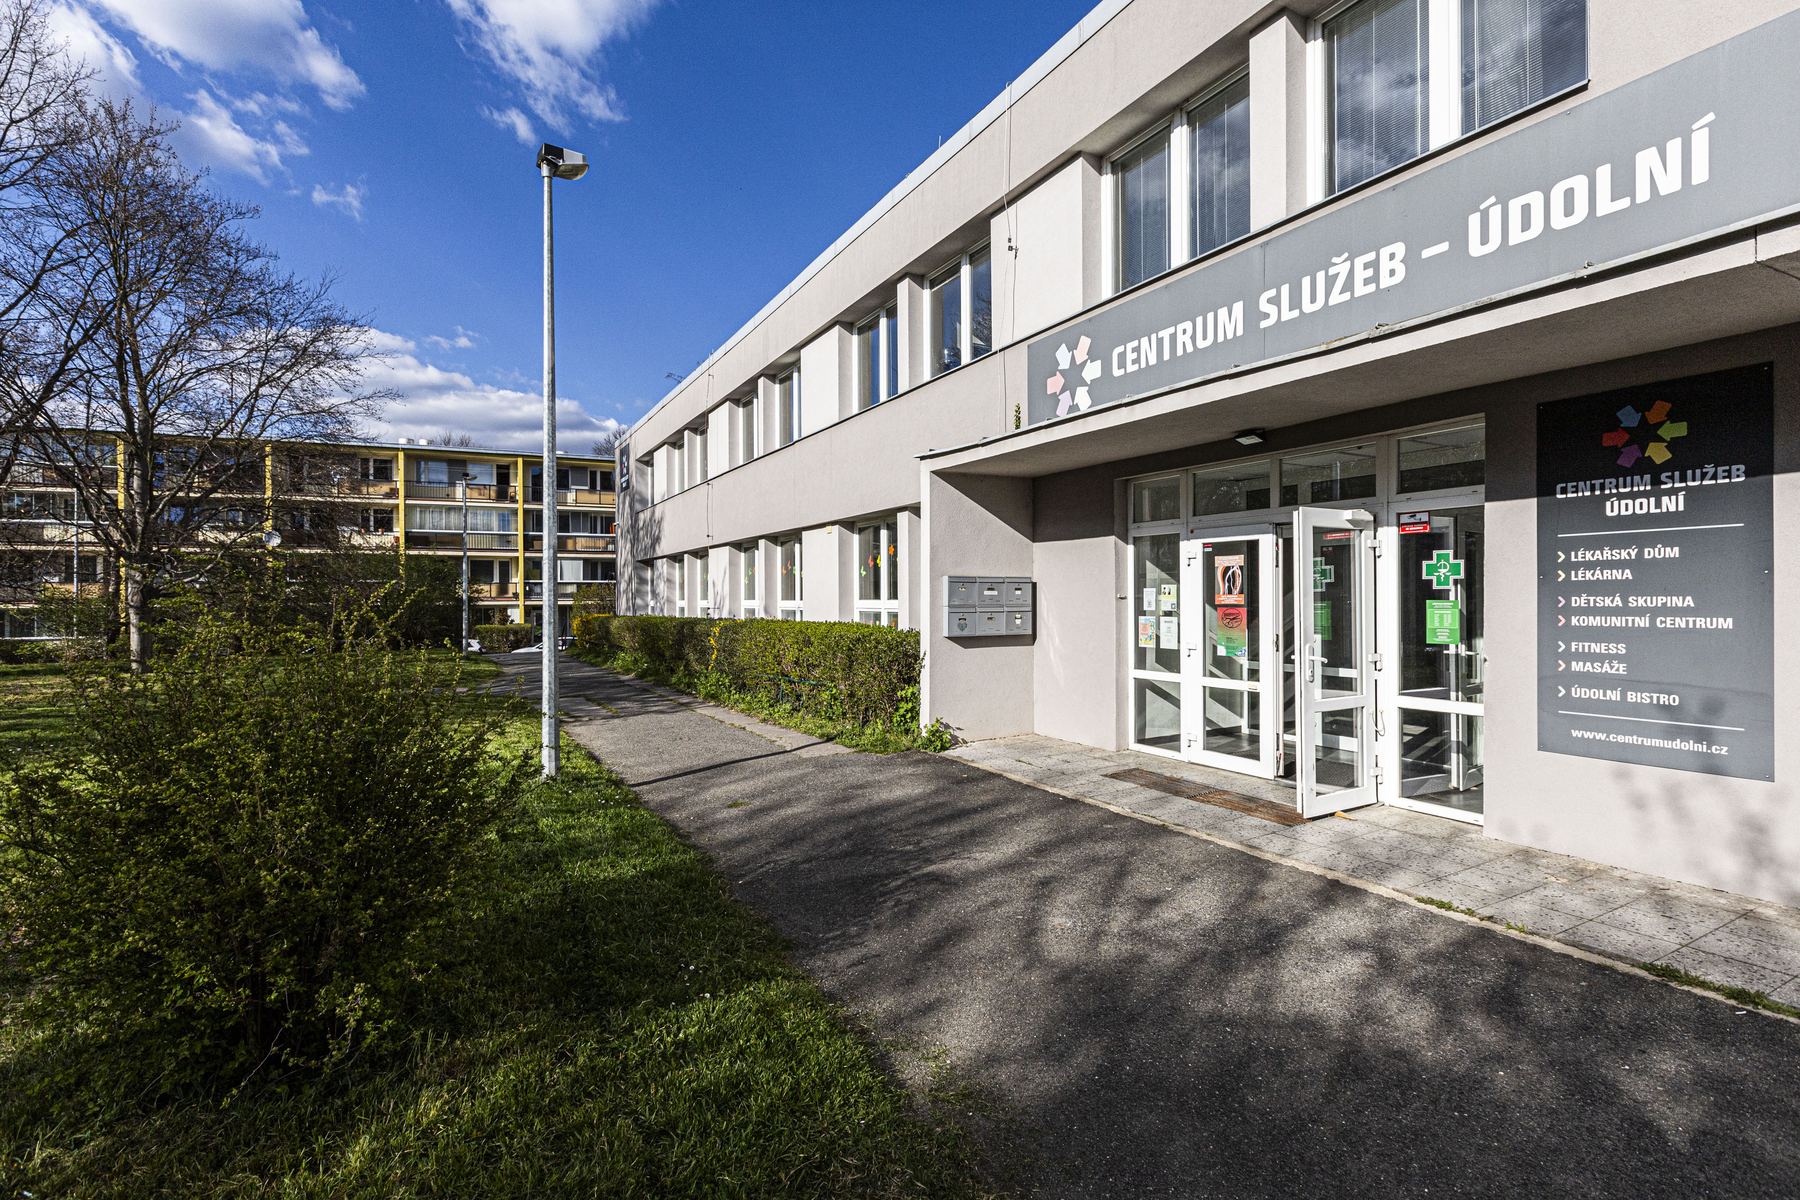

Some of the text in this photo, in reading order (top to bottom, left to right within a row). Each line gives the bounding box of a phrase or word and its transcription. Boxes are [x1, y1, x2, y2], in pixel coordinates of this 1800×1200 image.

[1111, 300, 1243, 377] CENTRUM
[1259, 241, 1407, 329] SLUŽEB
[1468, 113, 1716, 258] ÚDOLNÍ
[1556, 464, 1746, 499] CENTRUM SLUŽEB
[1605, 492, 1685, 516] ÚDOLNÍ
[1571, 544, 1680, 561] LÉKAŘSKÝ DŮM
[1571, 566, 1632, 581] LÉKÁRNA
[1571, 593, 1694, 608] DĚTSKÁ SKUPINA
[1571, 614, 1733, 630] KOMUNITNÍ CENTRUM
[1571, 642, 1626, 654] FITNESS
[1571, 659, 1627, 675] MASÁŽE
[1571, 685, 1680, 706] ÚDOLNÍ BISTRO
[1571, 728, 1729, 755] www.centrumudolni.cz
